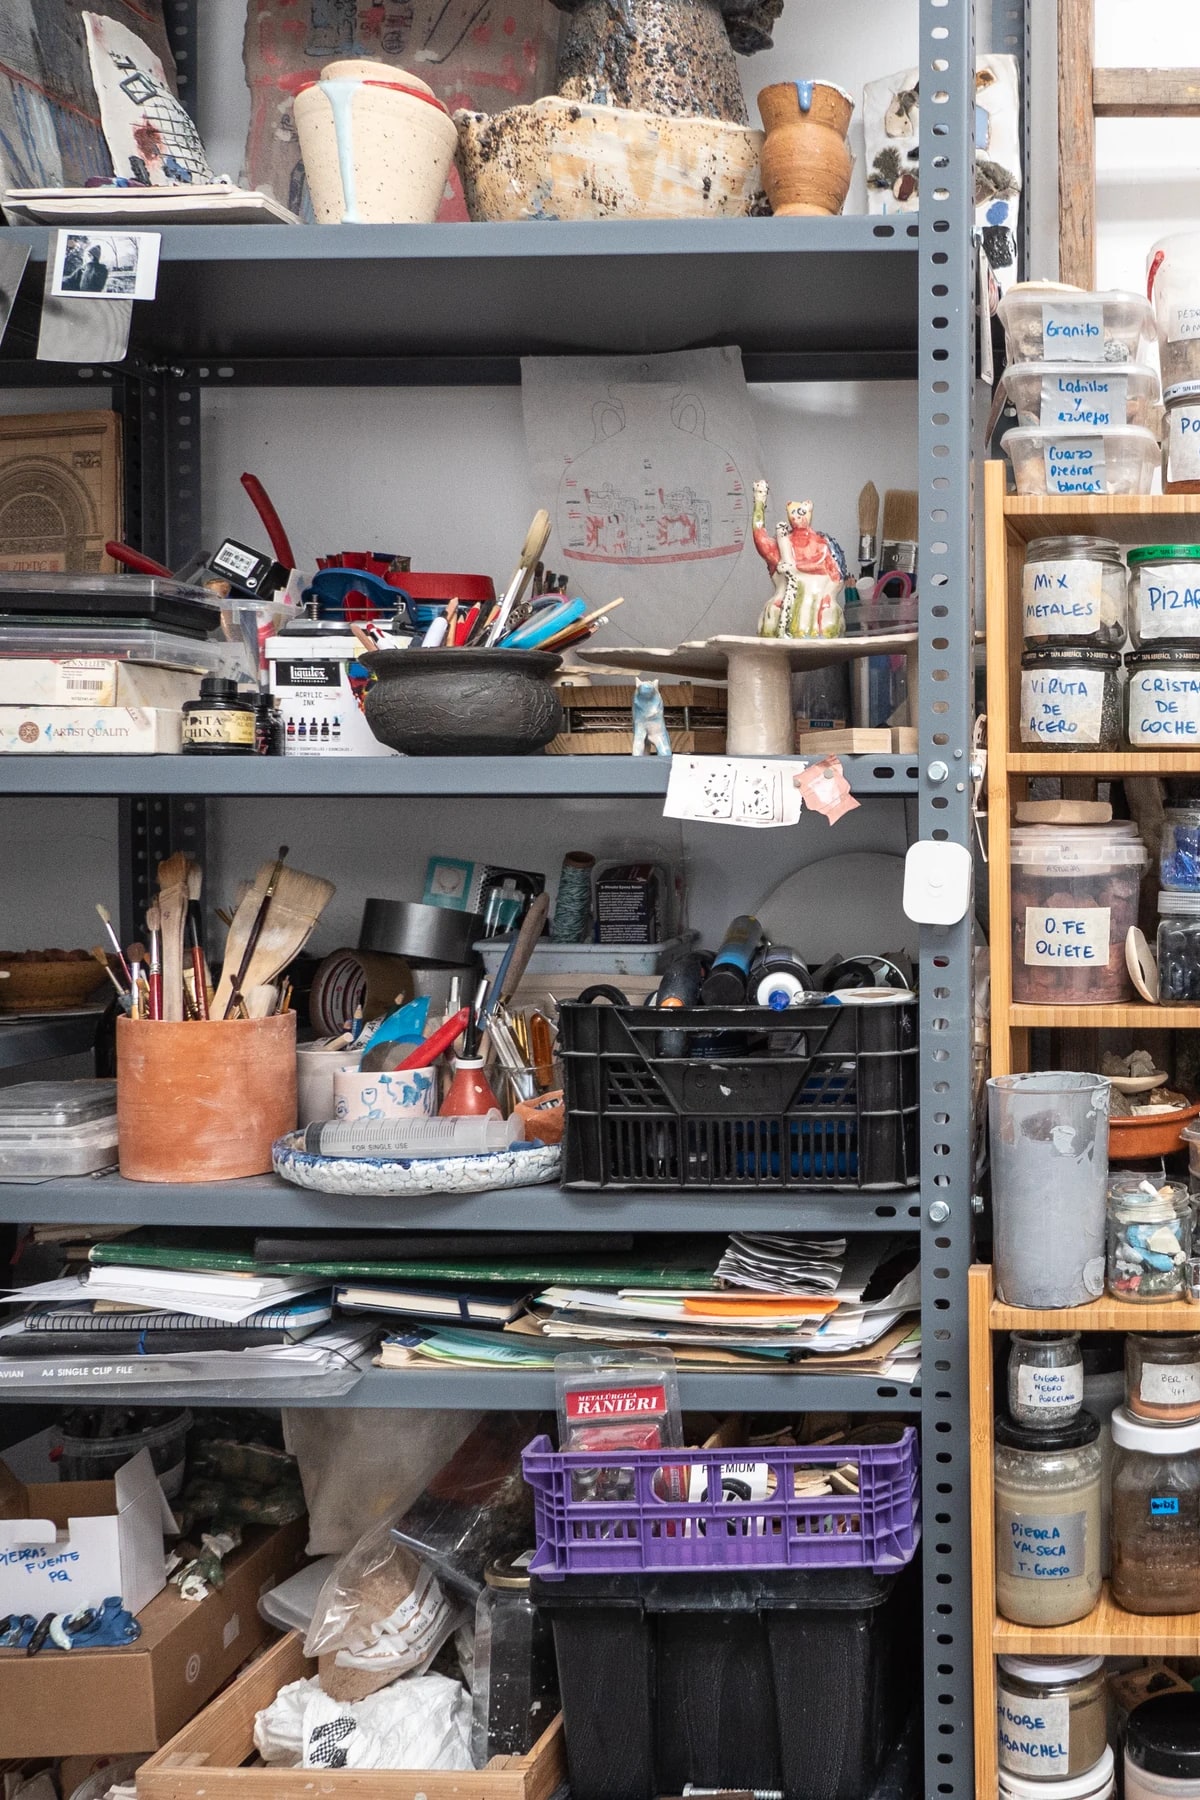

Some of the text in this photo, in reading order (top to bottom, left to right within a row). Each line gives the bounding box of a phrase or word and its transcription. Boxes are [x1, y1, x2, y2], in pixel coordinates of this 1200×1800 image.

[1046, 320, 1099, 337] Granito
[1058, 378, 1109, 393] Ladrillos
[1074, 397, 1082, 410] y
[1057, 411, 1110, 425] azulejos
[1049, 446, 1093, 460] Cuarzo
[1057, 479, 1101, 493] blancos
[1034, 573, 1068, 591] MIX
[1026, 602, 1094, 618] METALES
[290, 665, 329, 681] Liquitex
[1031, 678, 1088, 696] VIRUTA
[1042, 703, 1062, 717] DE
[1155, 700, 1179, 714] DE
[54, 727, 130, 739] ARTIST QUALITY
[184, 729, 223, 738] CHINA
[1030, 720, 1078, 734] ACERO
[1140, 719, 1198, 735] COCHE
[1035, 940, 1095, 959] OLIETE
[42, 1369, 54, 1377] A4
[58, 1367, 89, 1377] SINGLE
[92, 1366, 112, 1375] CLIP
[116, 1365, 133, 1374] FILE
[578, 1392, 637, 1402] METALÚRGICA
[576, 1396, 658, 1414] RANIERI
[702, 1463, 756, 1474] PEMIUM
[1011, 1522, 1060, 1539] PIEDRA
[25, 1551, 80, 1574] FUENTE
[1034, 1563, 1070, 1576] Grueso
[998, 1729, 1068, 1758] ABANCHEL
